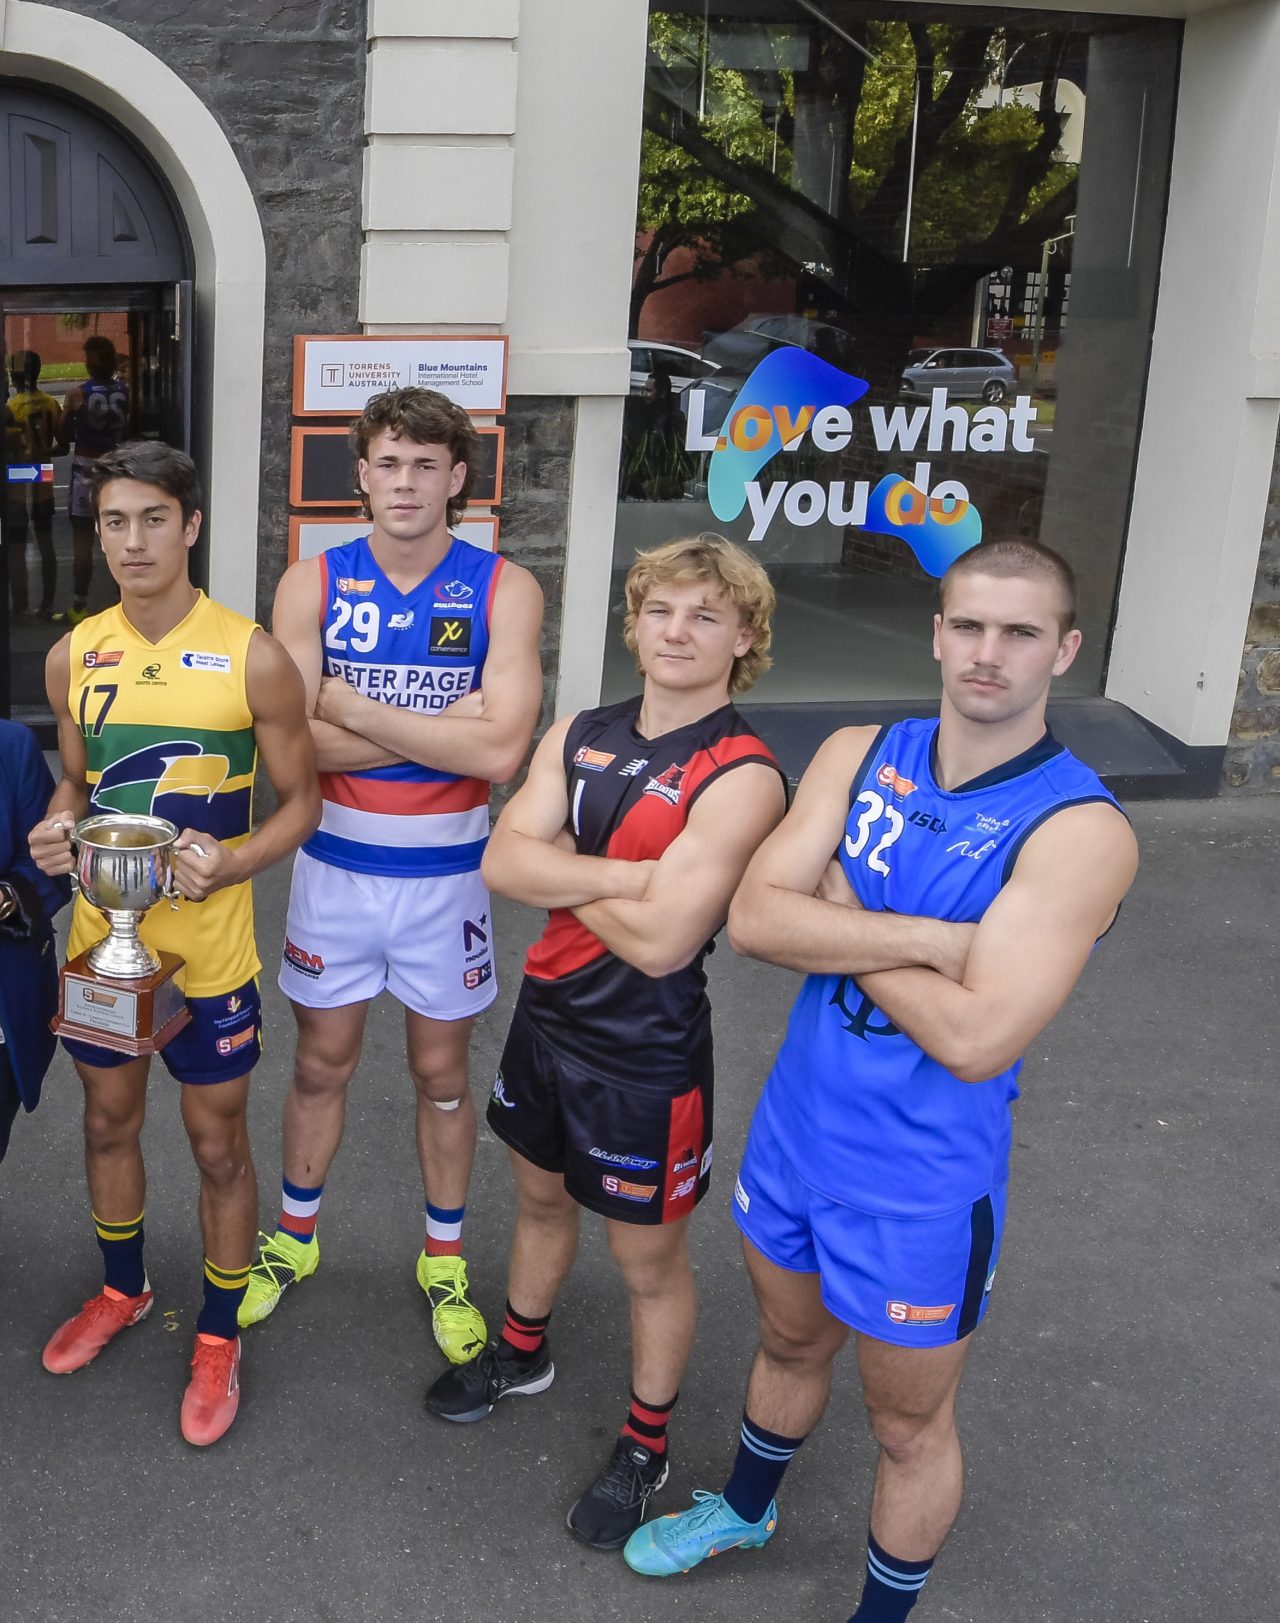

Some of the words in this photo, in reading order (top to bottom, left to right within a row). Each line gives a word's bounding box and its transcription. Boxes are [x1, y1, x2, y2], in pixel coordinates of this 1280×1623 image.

[418, 363, 438, 371] Blue
[440, 363, 488, 371] Mountains
[418, 379, 460, 388] Management
[685, 389, 853, 452] Love
[870, 387, 1037, 452] what
[744, 480, 870, 541] you
[885, 462, 969, 525] do
[326, 597, 380, 653] 29
[332, 662, 398, 690] PETER
[406, 669, 471, 692] PAGE
[79, 683, 118, 737] 17
[573, 779, 586, 836] 1
[844, 790, 905, 879] 32
